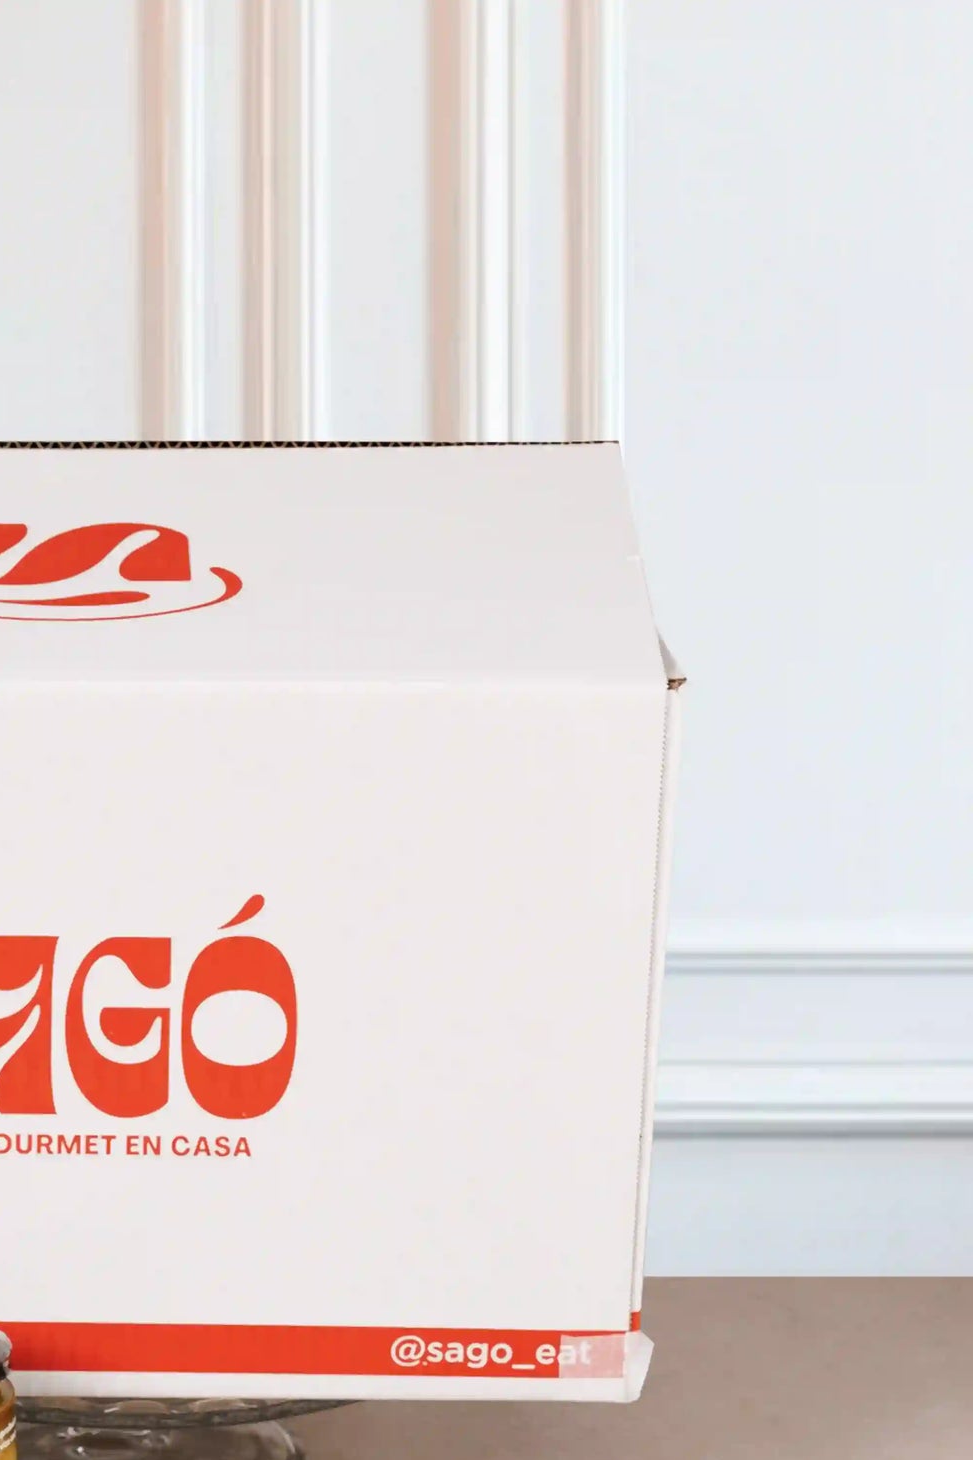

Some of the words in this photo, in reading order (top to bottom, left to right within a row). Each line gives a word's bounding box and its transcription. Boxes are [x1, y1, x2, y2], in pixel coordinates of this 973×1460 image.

[126, 1135, 162, 1156] EN
[170, 1136, 252, 1157] CASA
[390, 1335, 592, 1370] @sago_eat
